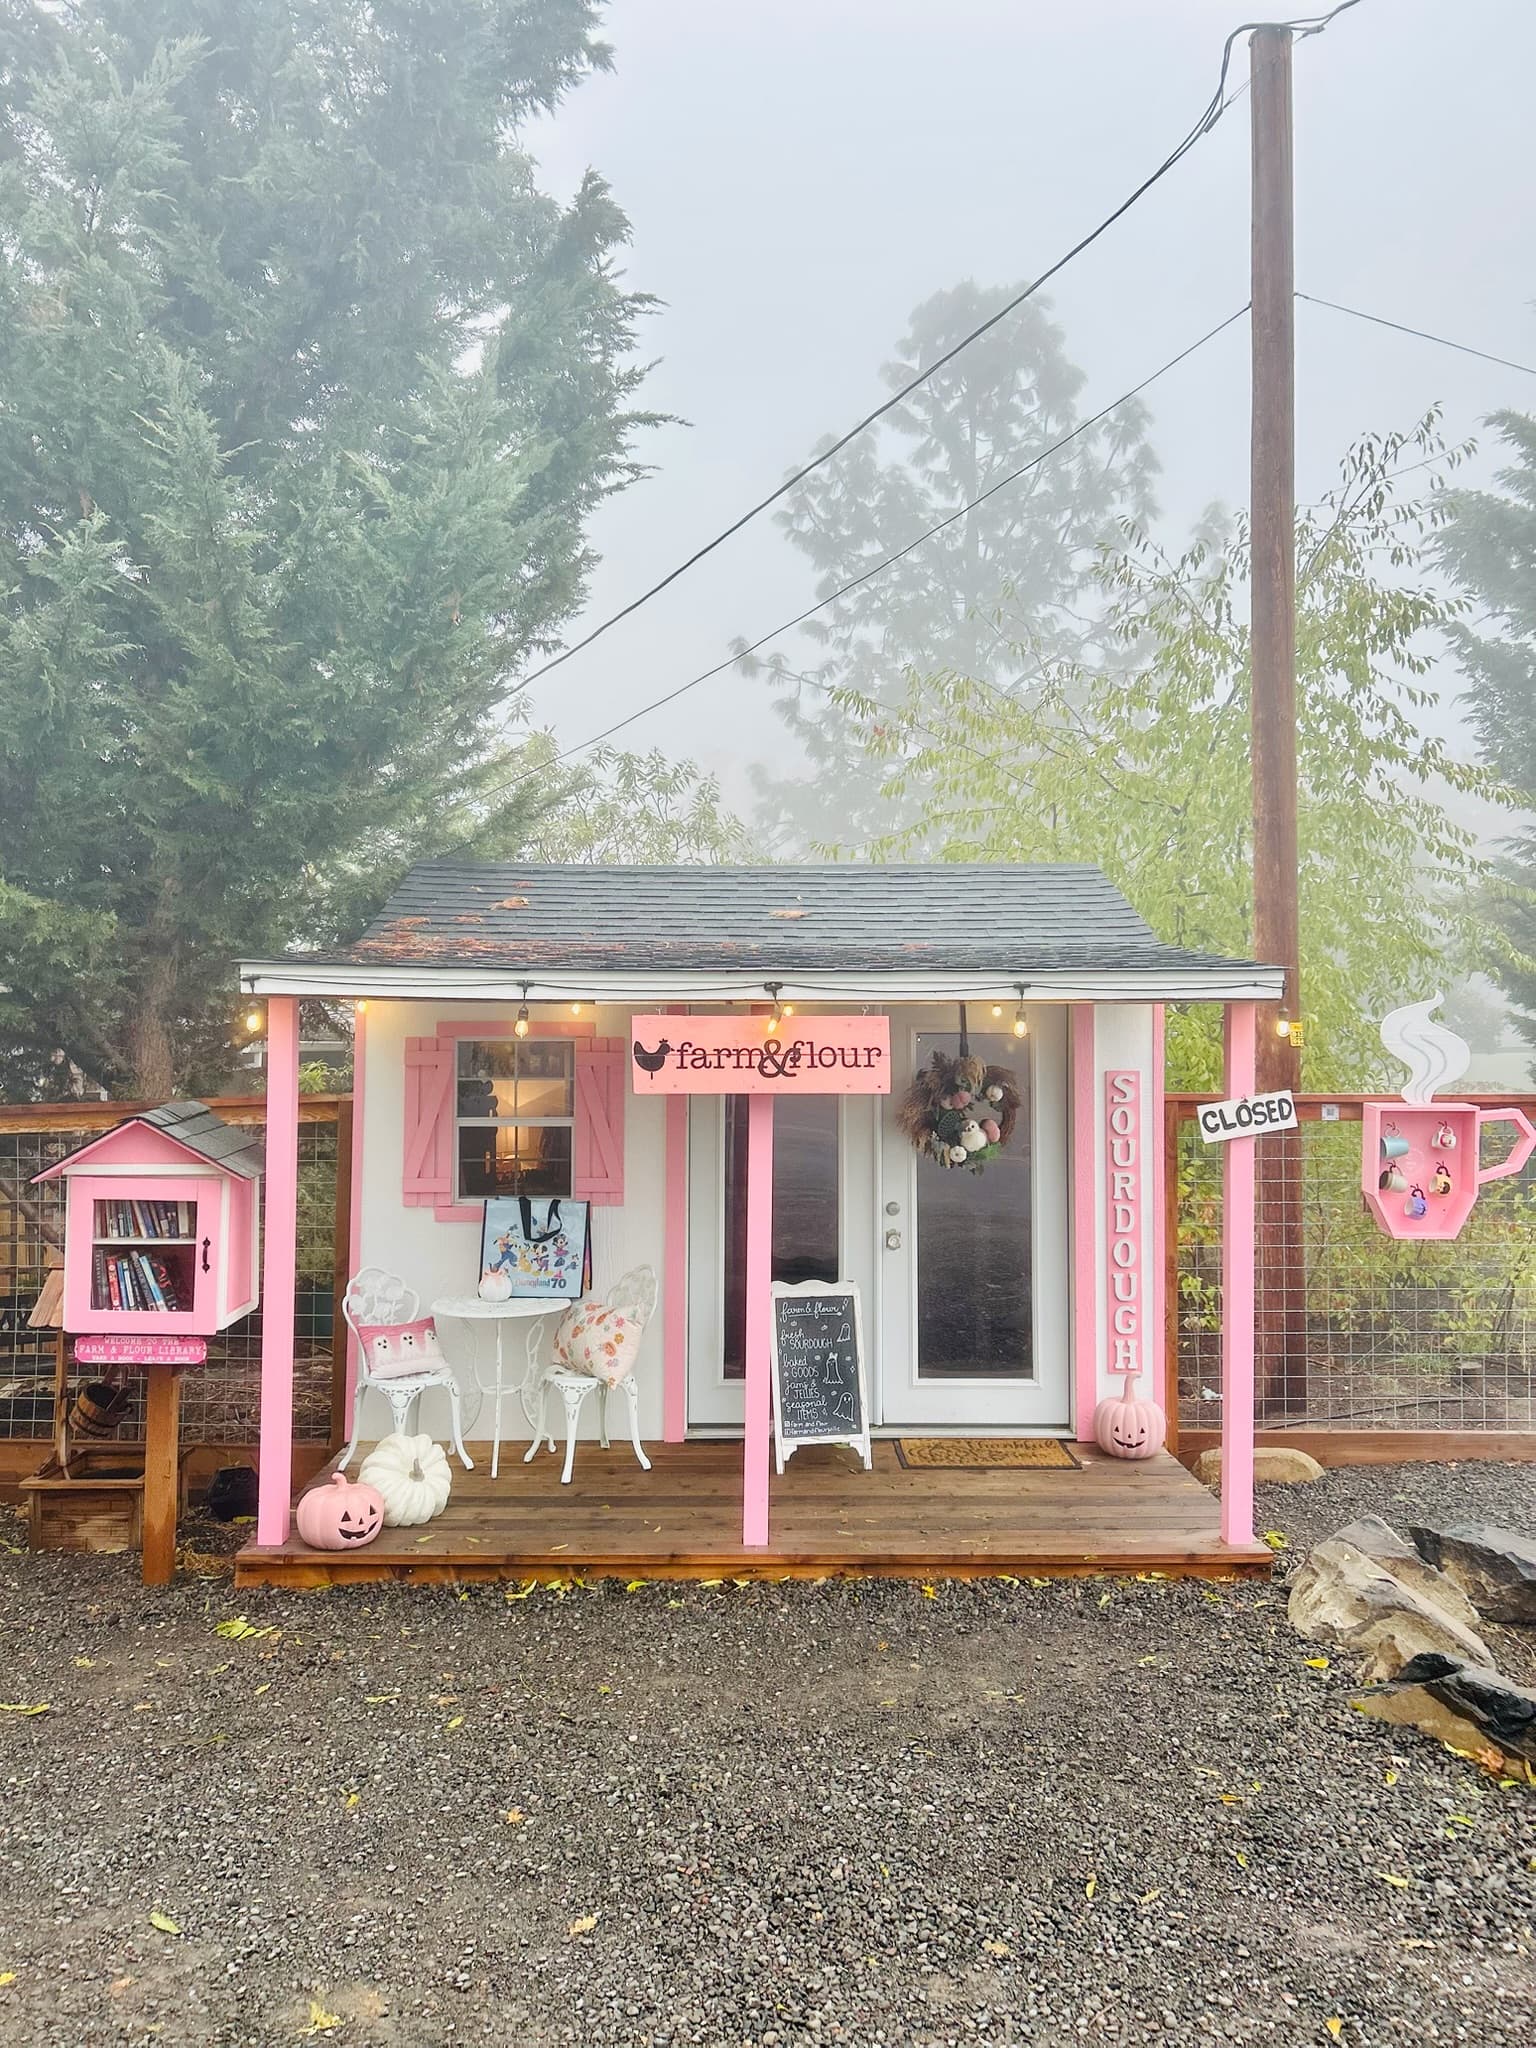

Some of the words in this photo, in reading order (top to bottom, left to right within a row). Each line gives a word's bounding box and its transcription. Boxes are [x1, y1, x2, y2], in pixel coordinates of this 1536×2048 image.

[1201, 1098, 1293, 1134] CLOSED
[1111, 1074, 1138, 1371] SOURDOUGH
[814, 1302, 839, 1319] flour
[104, 1337, 142, 1345] WELCOME
[147, 1337, 158, 1345] TO
[780, 1328, 804, 1346] fresh
[79, 1344, 105, 1354] FARM
[124, 1345, 153, 1355] FLOUR
[159, 1345, 202, 1356] LIBRARY
[789, 1338, 833, 1350] SOURDOUGH
[783, 1353, 808, 1368] baked
[791, 1366, 820, 1378] GOODS
[793, 1387, 820, 1399] JELLIES
[785, 1395, 828, 1413] seasonal
[797, 1408, 818, 1420] ITEMS
